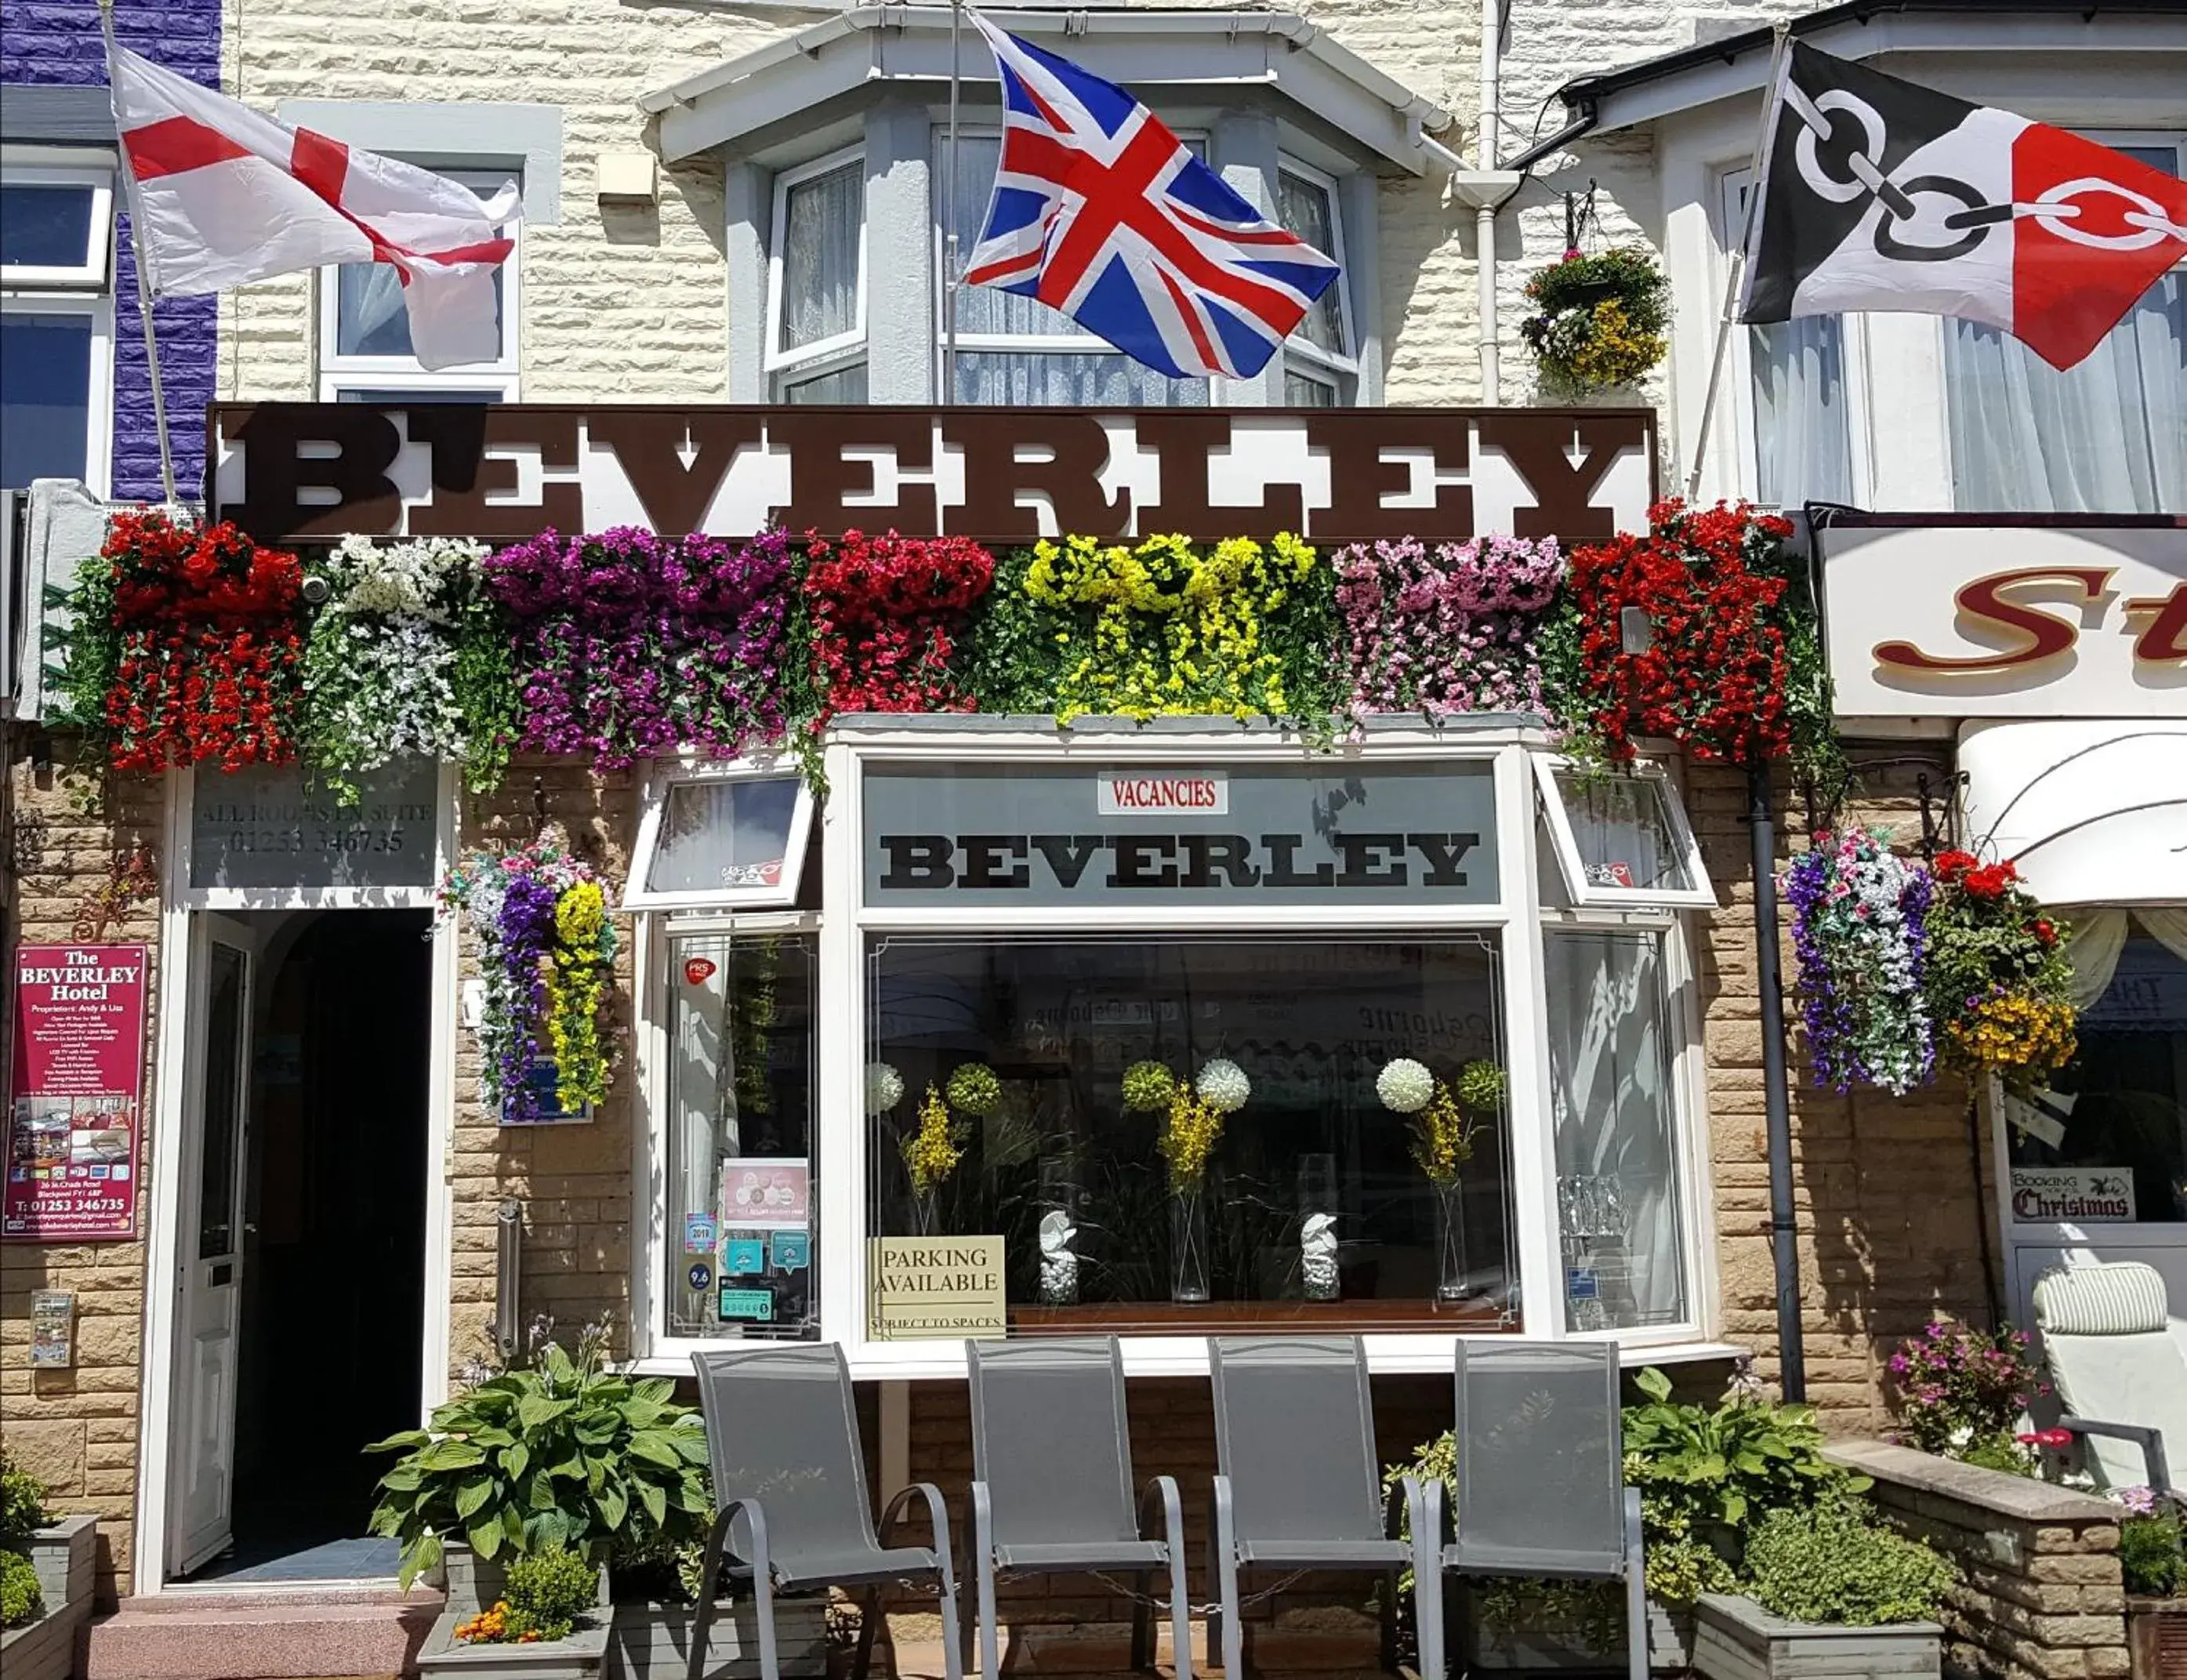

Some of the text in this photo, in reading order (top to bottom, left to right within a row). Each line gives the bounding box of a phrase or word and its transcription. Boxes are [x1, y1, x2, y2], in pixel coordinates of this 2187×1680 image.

[221, 411, 1645, 538] BEVERLEY
[1112, 779, 1216, 807] VACANCIES
[880, 833, 1481, 889] BEVERLEY
[65, 951, 99, 965] The
[20, 967, 140, 983] BEVERLEY
[51, 985, 107, 1000] Hotel
[16, 1198, 125, 1212] T: 01253 346735
[2012, 1188, 2129, 1217] Christmas
[883, 1248, 988, 1268] PARKING
[691, 1270, 709, 1283] 9.6
[874, 1272, 999, 1293] AVAILABLE
[930, 1318, 950, 1328] TO
[952, 1317, 1002, 1328] SPACES
